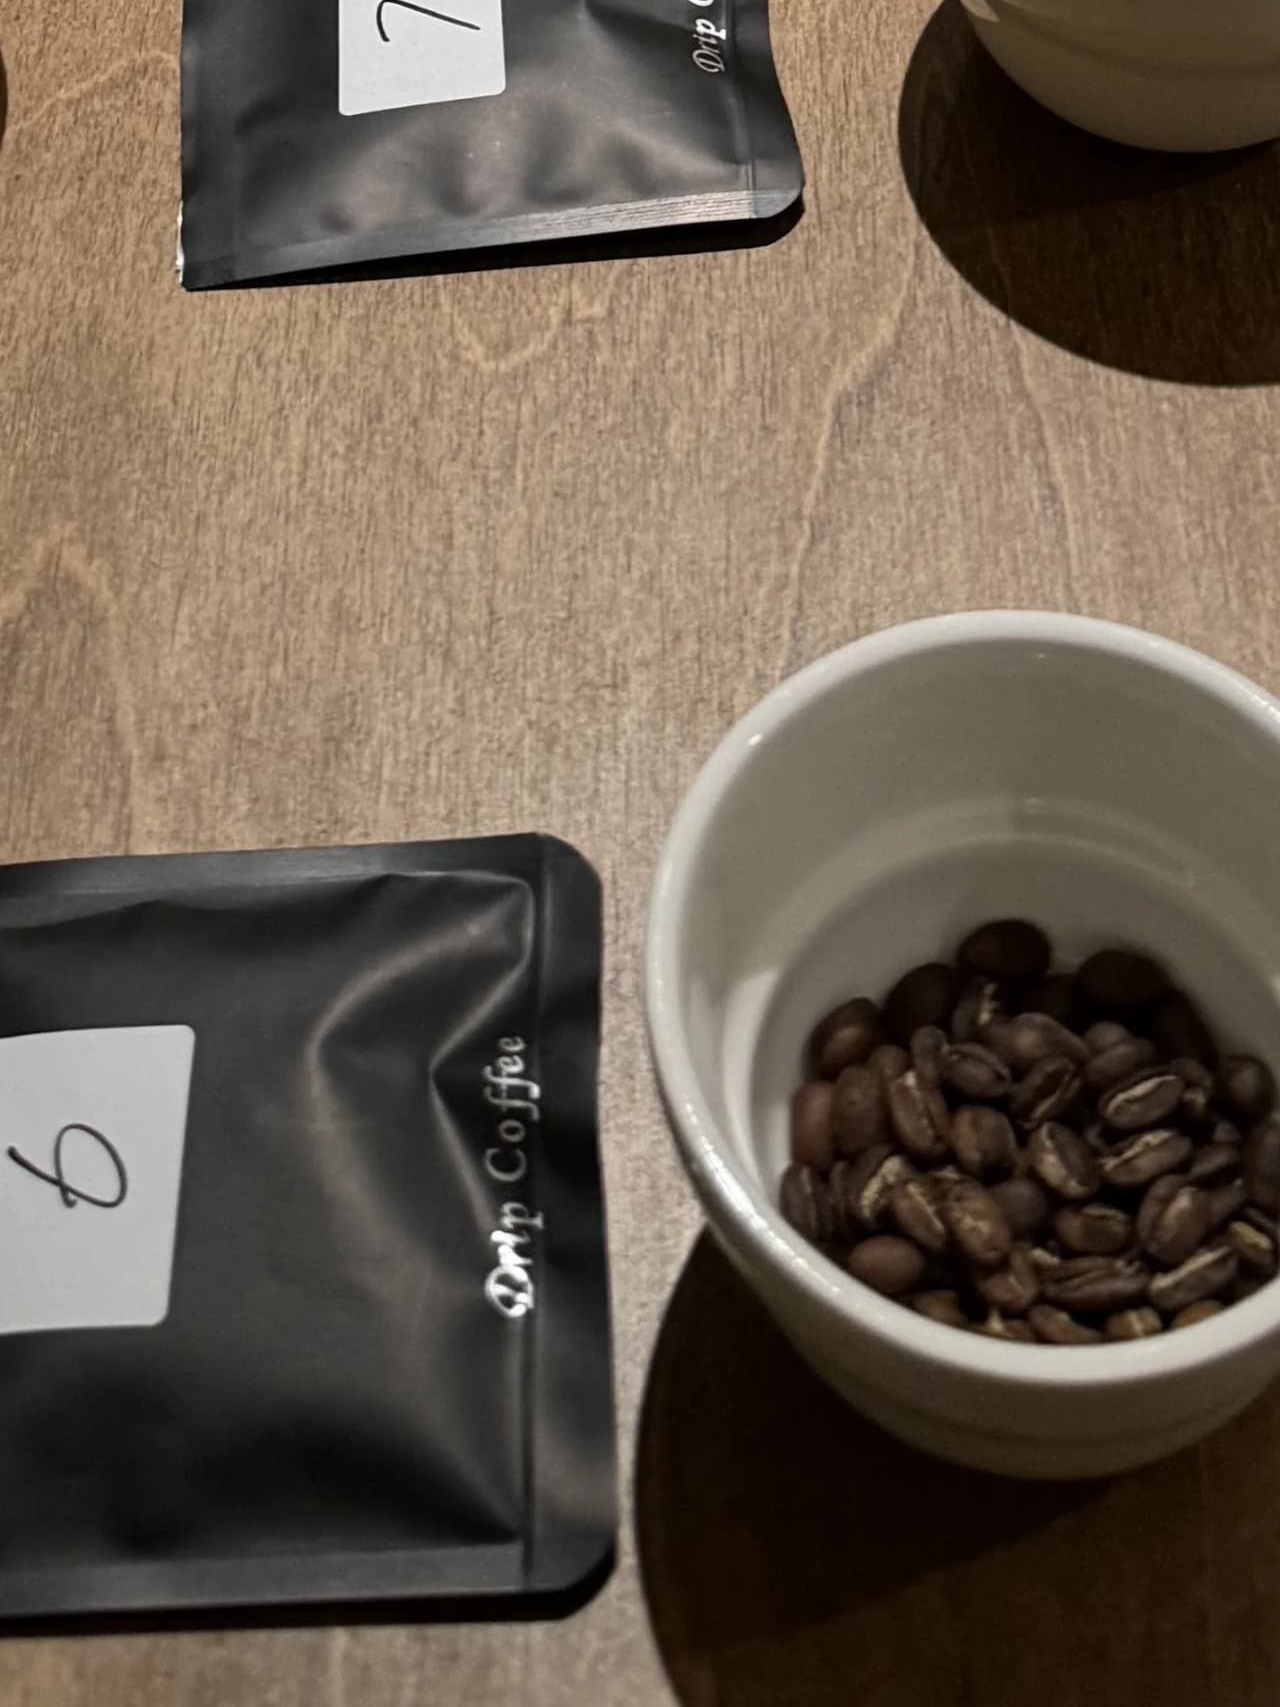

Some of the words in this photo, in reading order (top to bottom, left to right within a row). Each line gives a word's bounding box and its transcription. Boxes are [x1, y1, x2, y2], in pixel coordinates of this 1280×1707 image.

[692, 14, 729, 72] Drip
[483, 1034, 540, 1184] Coffee
[6, 1122, 128, 1209] 6
